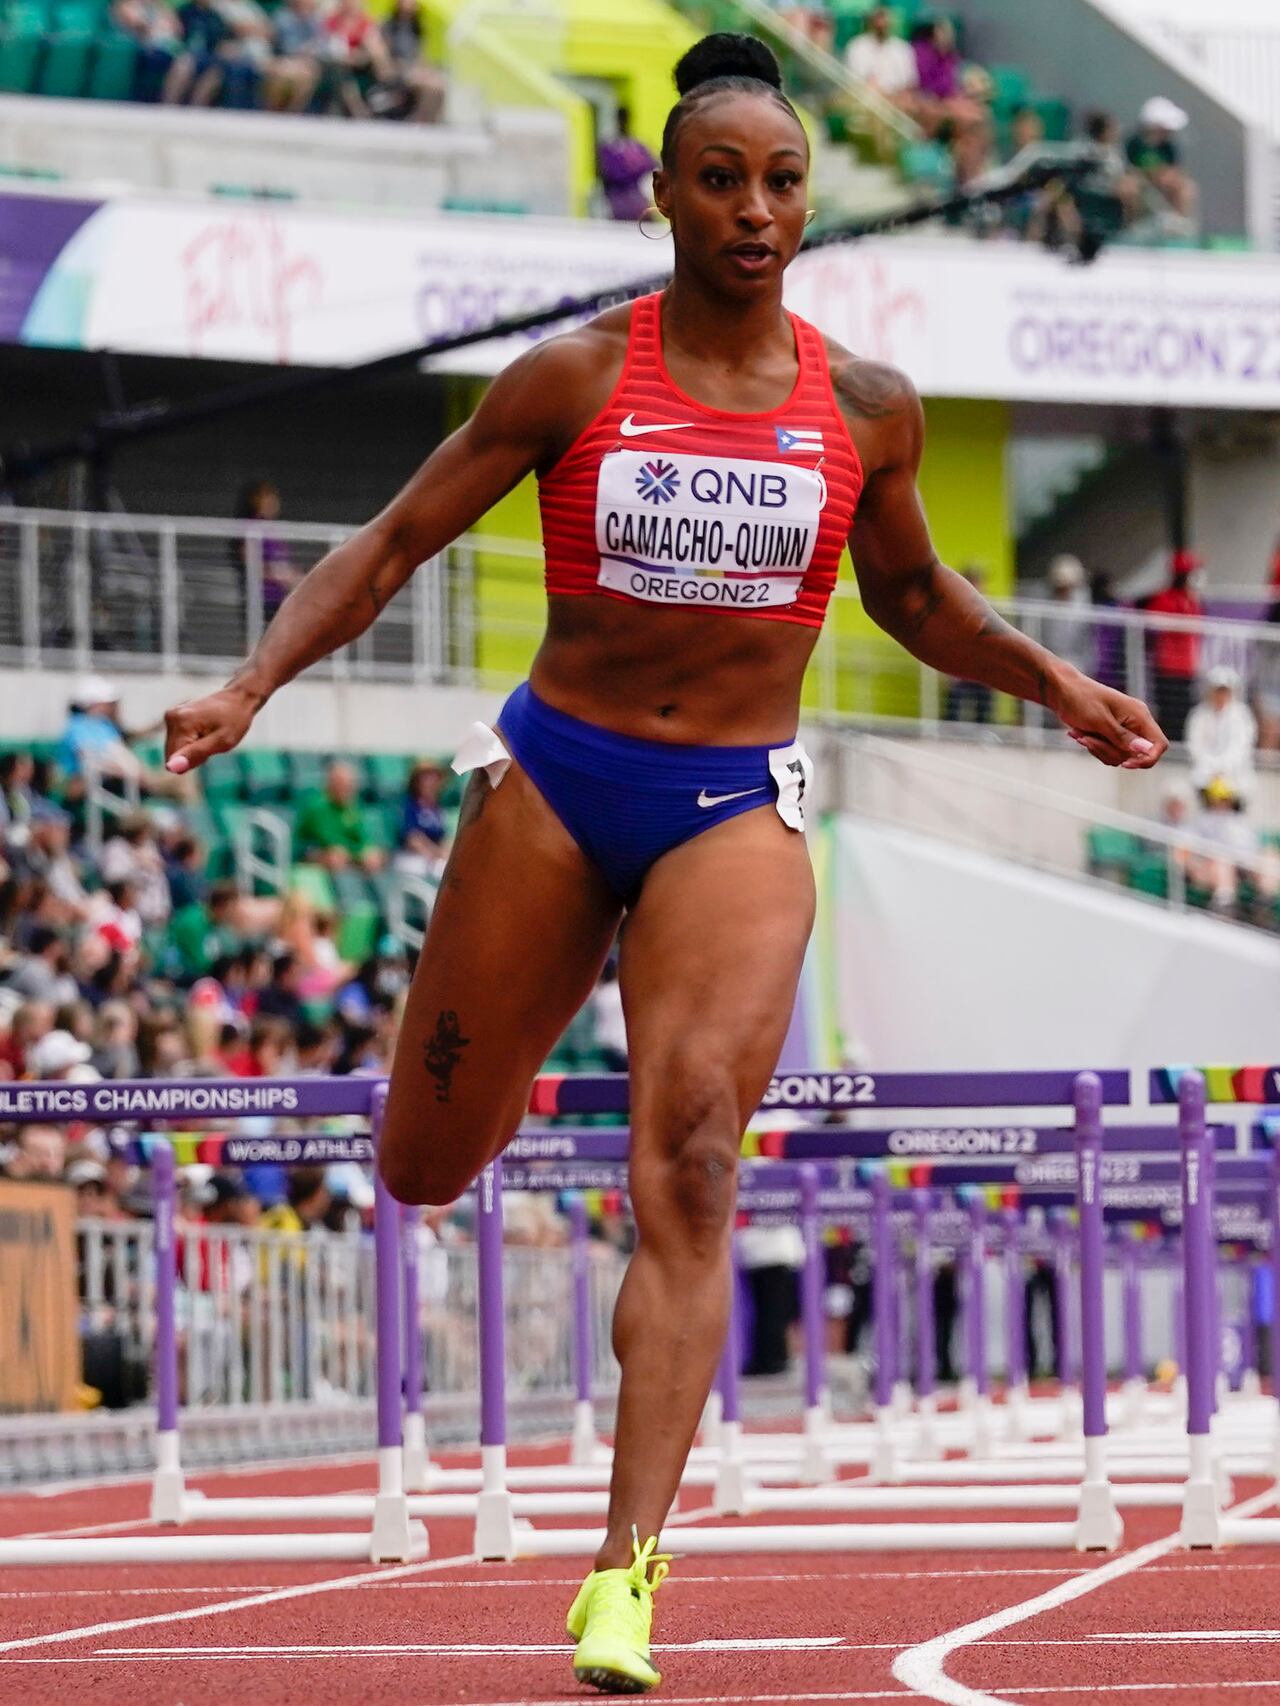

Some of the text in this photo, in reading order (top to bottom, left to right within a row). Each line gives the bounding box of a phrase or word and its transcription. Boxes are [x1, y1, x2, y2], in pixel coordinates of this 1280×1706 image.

[690, 468, 788, 508] QNB
[605, 511, 809, 569] CAMACHO-QUINN
[630, 573, 770, 603] OREGON22
[0, 1087, 298, 1113] LETICS CHAMPIONSHIPS
[761, 1075, 876, 1105] GON22
[227, 1140, 302, 1161] WORLD
